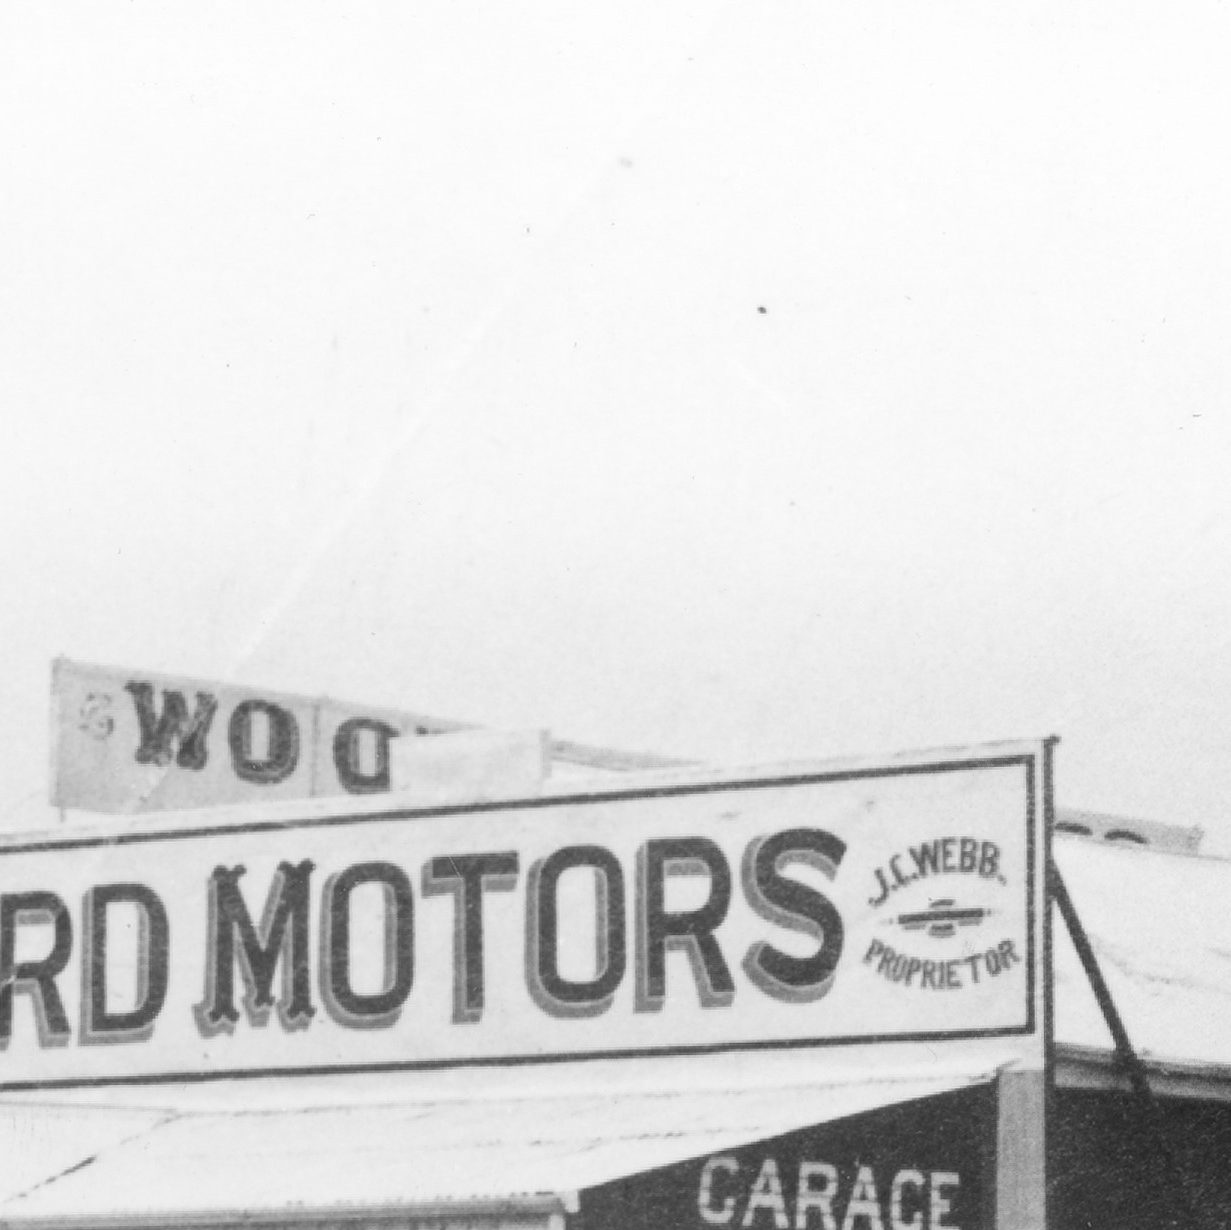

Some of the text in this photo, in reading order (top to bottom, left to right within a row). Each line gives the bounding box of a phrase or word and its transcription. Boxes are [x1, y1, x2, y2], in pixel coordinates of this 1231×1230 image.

[124, 678, 429, 796] WOO
[192, 827, 849, 1038] MOTORS
[863, 938, 1022, 990] PROPRIETOR
